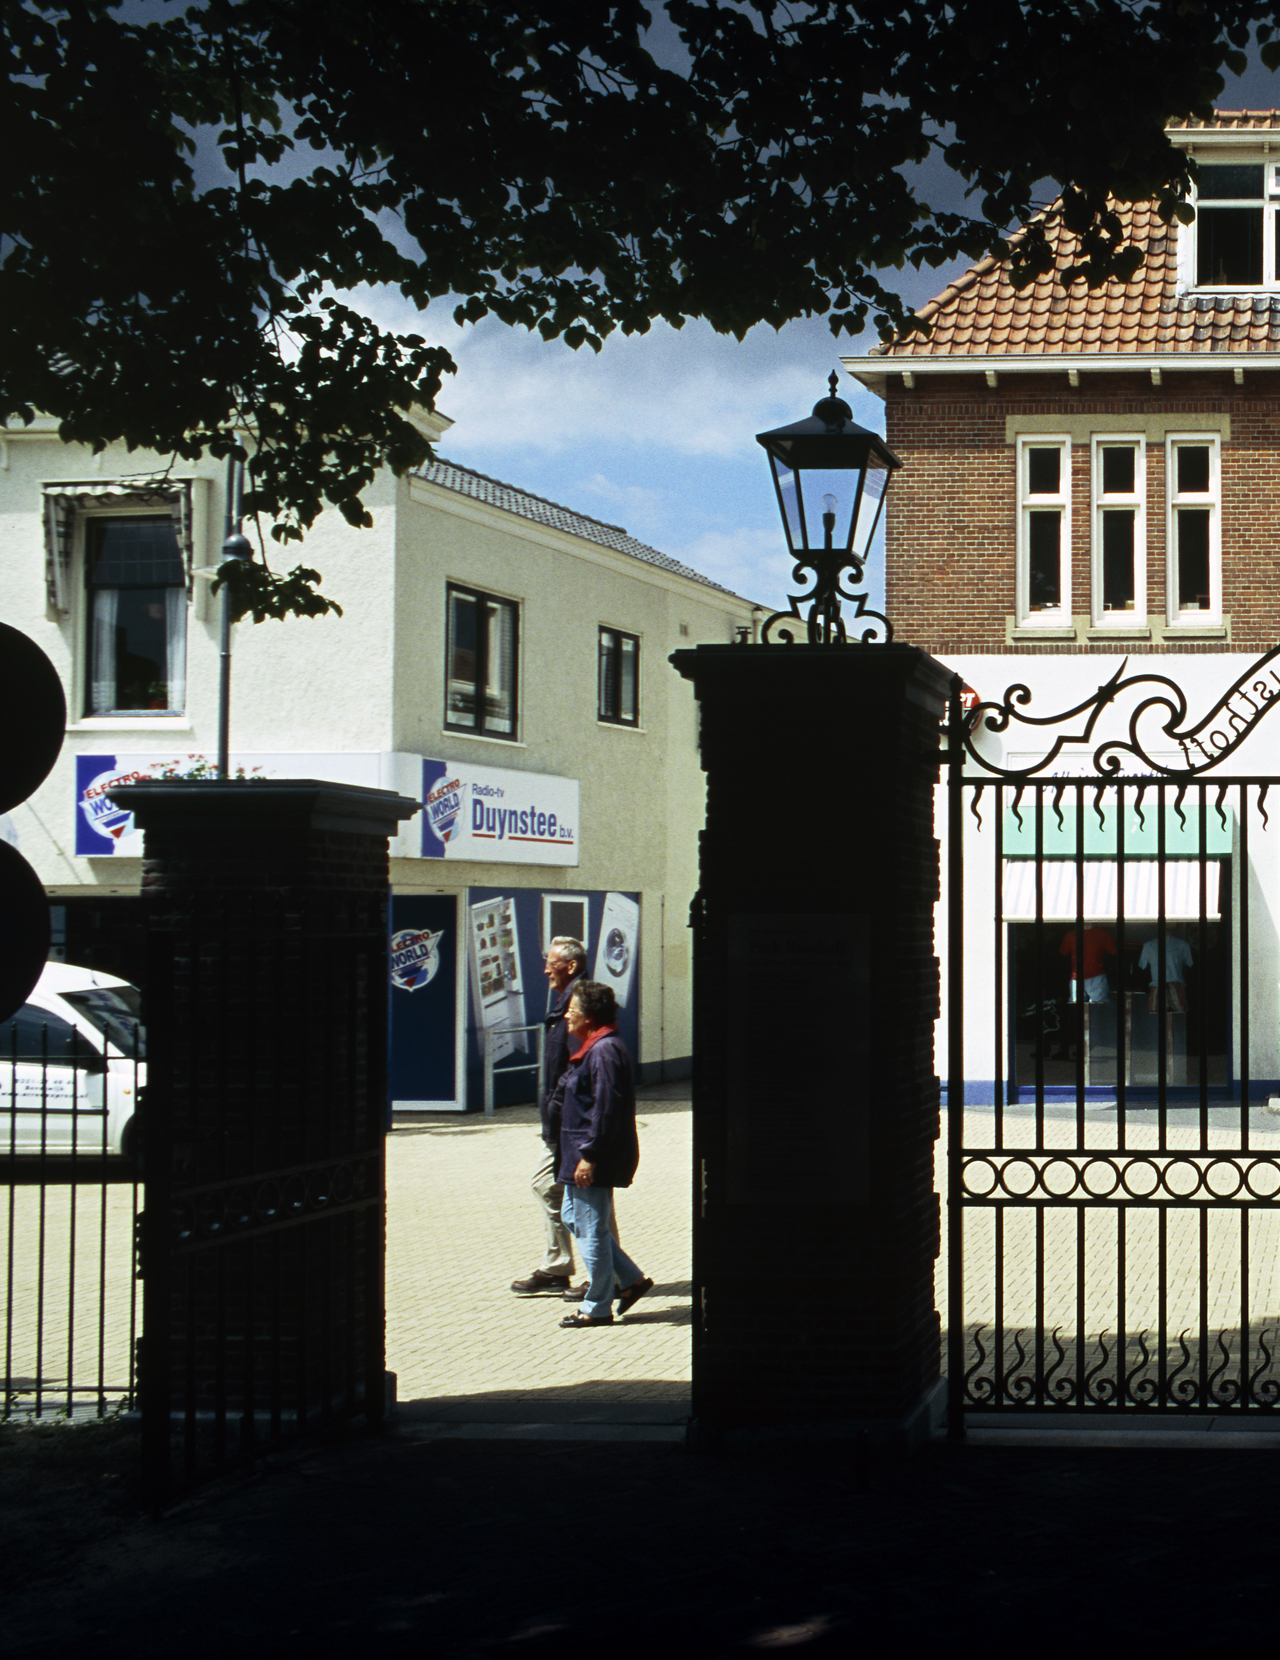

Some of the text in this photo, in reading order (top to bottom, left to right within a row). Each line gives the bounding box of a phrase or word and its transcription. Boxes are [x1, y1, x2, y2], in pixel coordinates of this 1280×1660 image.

[85, 771, 140, 799] ELECTRO
[427, 778, 461, 803] ELECTRO
[472, 783, 505, 798] Radio-tv
[430, 792, 460, 820] WORLD
[472, 798, 558, 840] Duynstee
[559, 825, 574, 839] b.v.
[392, 931, 430, 953] LECTRO
[392, 944, 429, 969] WORLD
